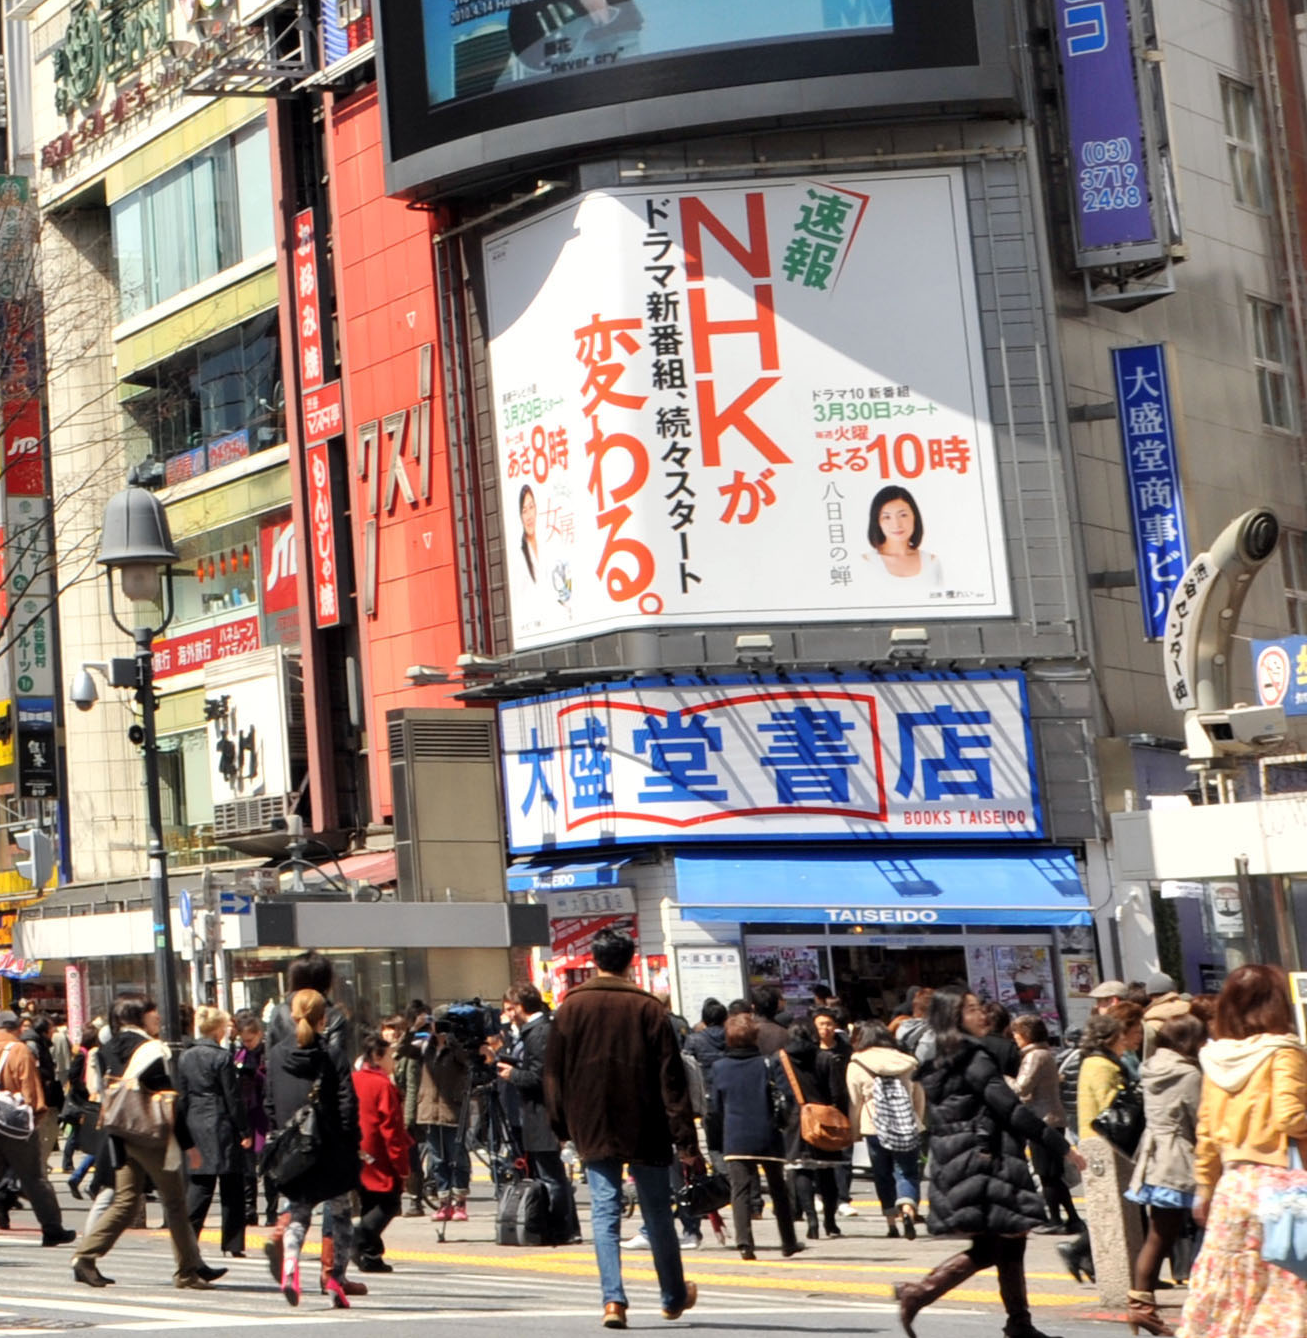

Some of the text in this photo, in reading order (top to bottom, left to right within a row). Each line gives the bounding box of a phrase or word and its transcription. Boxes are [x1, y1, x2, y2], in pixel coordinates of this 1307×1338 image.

[1081, 140, 1132, 165] (03)
[1081, 162, 1138, 188] 3719
[1082, 186, 1142, 213] 2468
[781, 188, 854, 292] 速報
[297, 223, 320, 380] お好み焼
[642, 198, 703, 595] ドラマ新番組、続々スタート
[812, 385, 910, 402] ドラマ10 新番組
[813, 400, 938, 423] 3月30日スタート
[507, 424, 570, 484] あさ8時
[574, 313, 663, 616] 変わる。
[818, 432, 971, 480] よる10時
[1123, 365, 1180, 619] 大盛堂商事ビル
[312, 454, 336, 617] もんじゃ焼
[822, 481, 853, 587] 八日目の蝉
[177, 638, 213, 666] 海外旅行
[1169, 561, 1209, 705] 渋谷センター街
[518, 704, 995, 817] 大盛堂書店
[903, 808, 1026, 827] BOOKS TAISEIDO
[825, 908, 939, 925] TAISEIDO
